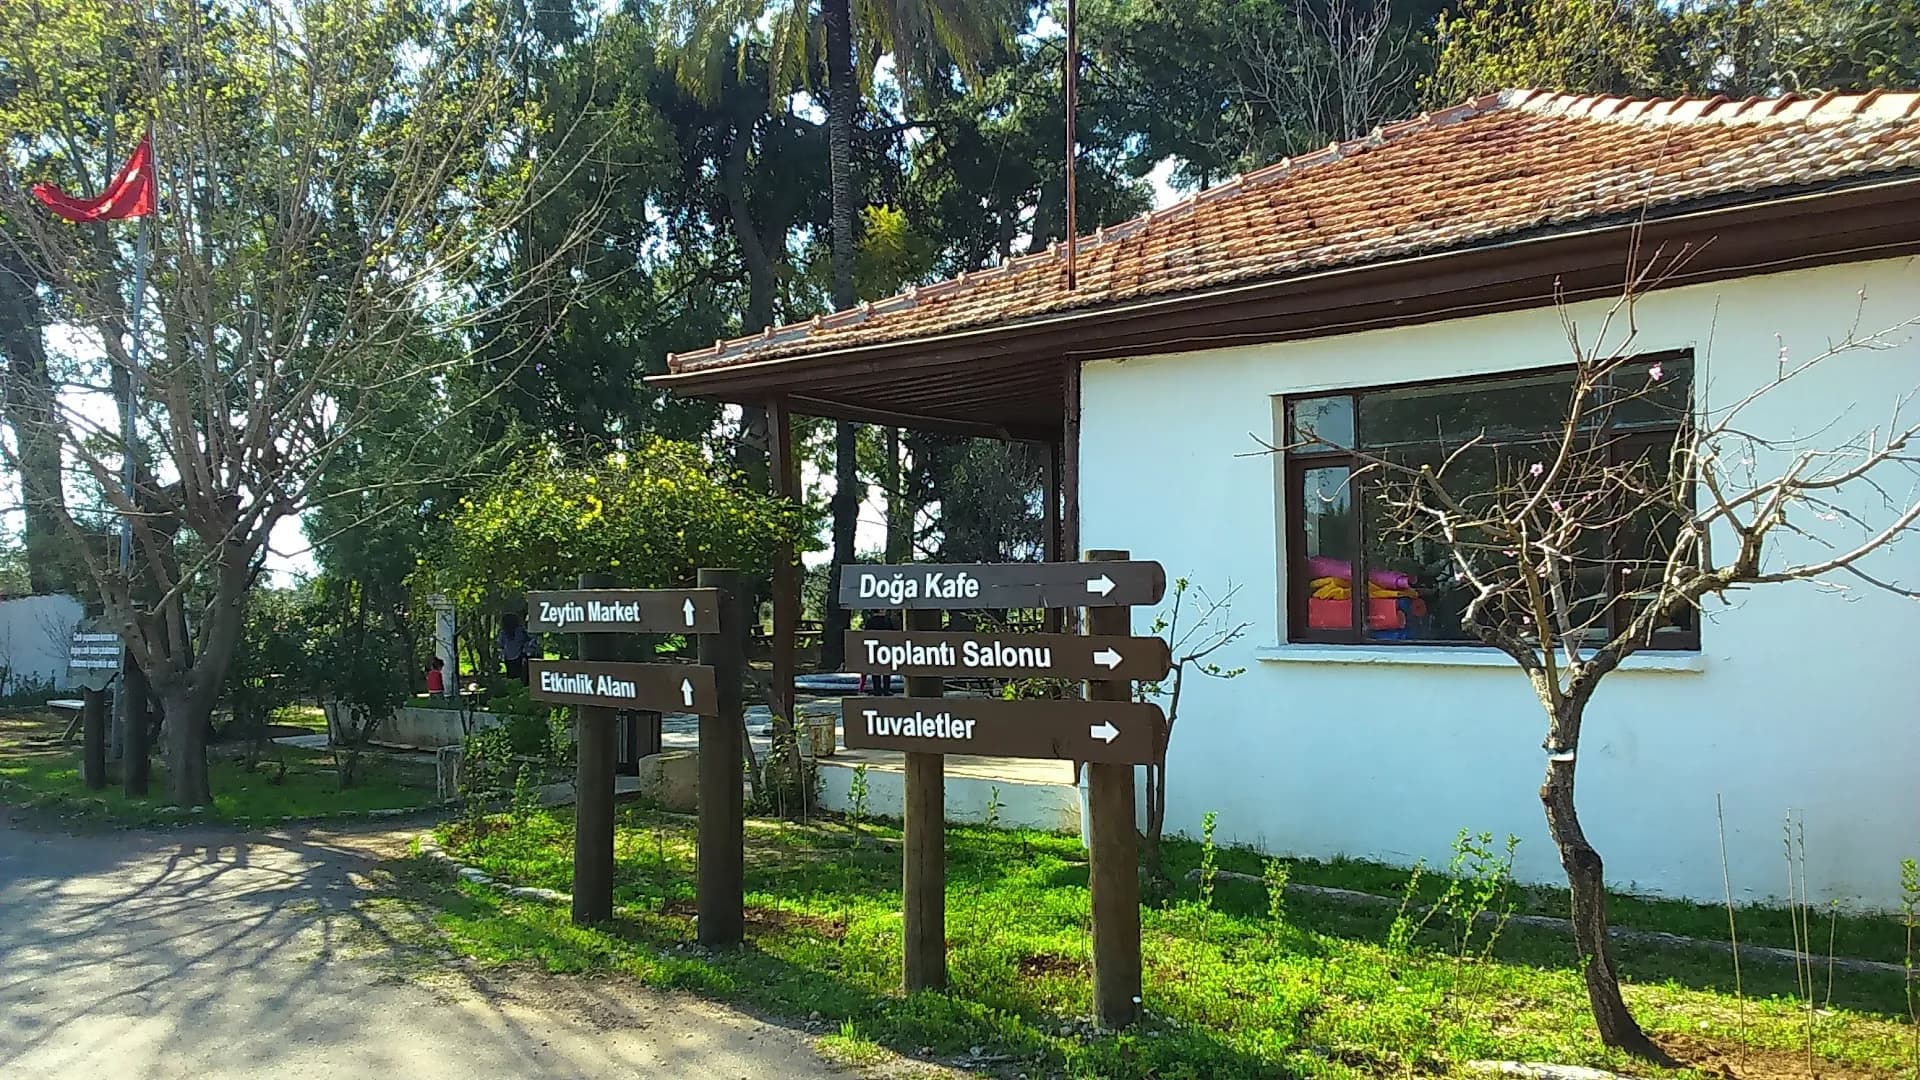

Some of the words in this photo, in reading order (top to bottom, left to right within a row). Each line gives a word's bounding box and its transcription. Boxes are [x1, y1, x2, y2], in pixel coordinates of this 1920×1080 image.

[859, 573, 918, 603] Doğa
[925, 572, 980, 598] Kafe
[539, 602, 585, 627] Zeytin
[587, 601, 641, 622] Market
[863, 640, 956, 671] Toplantı
[962, 640, 1051, 668] Salonu
[540, 671, 595, 695] Etkinlik
[596, 675, 637, 698] Alanı
[862, 710, 976, 739] Tuvaletler
